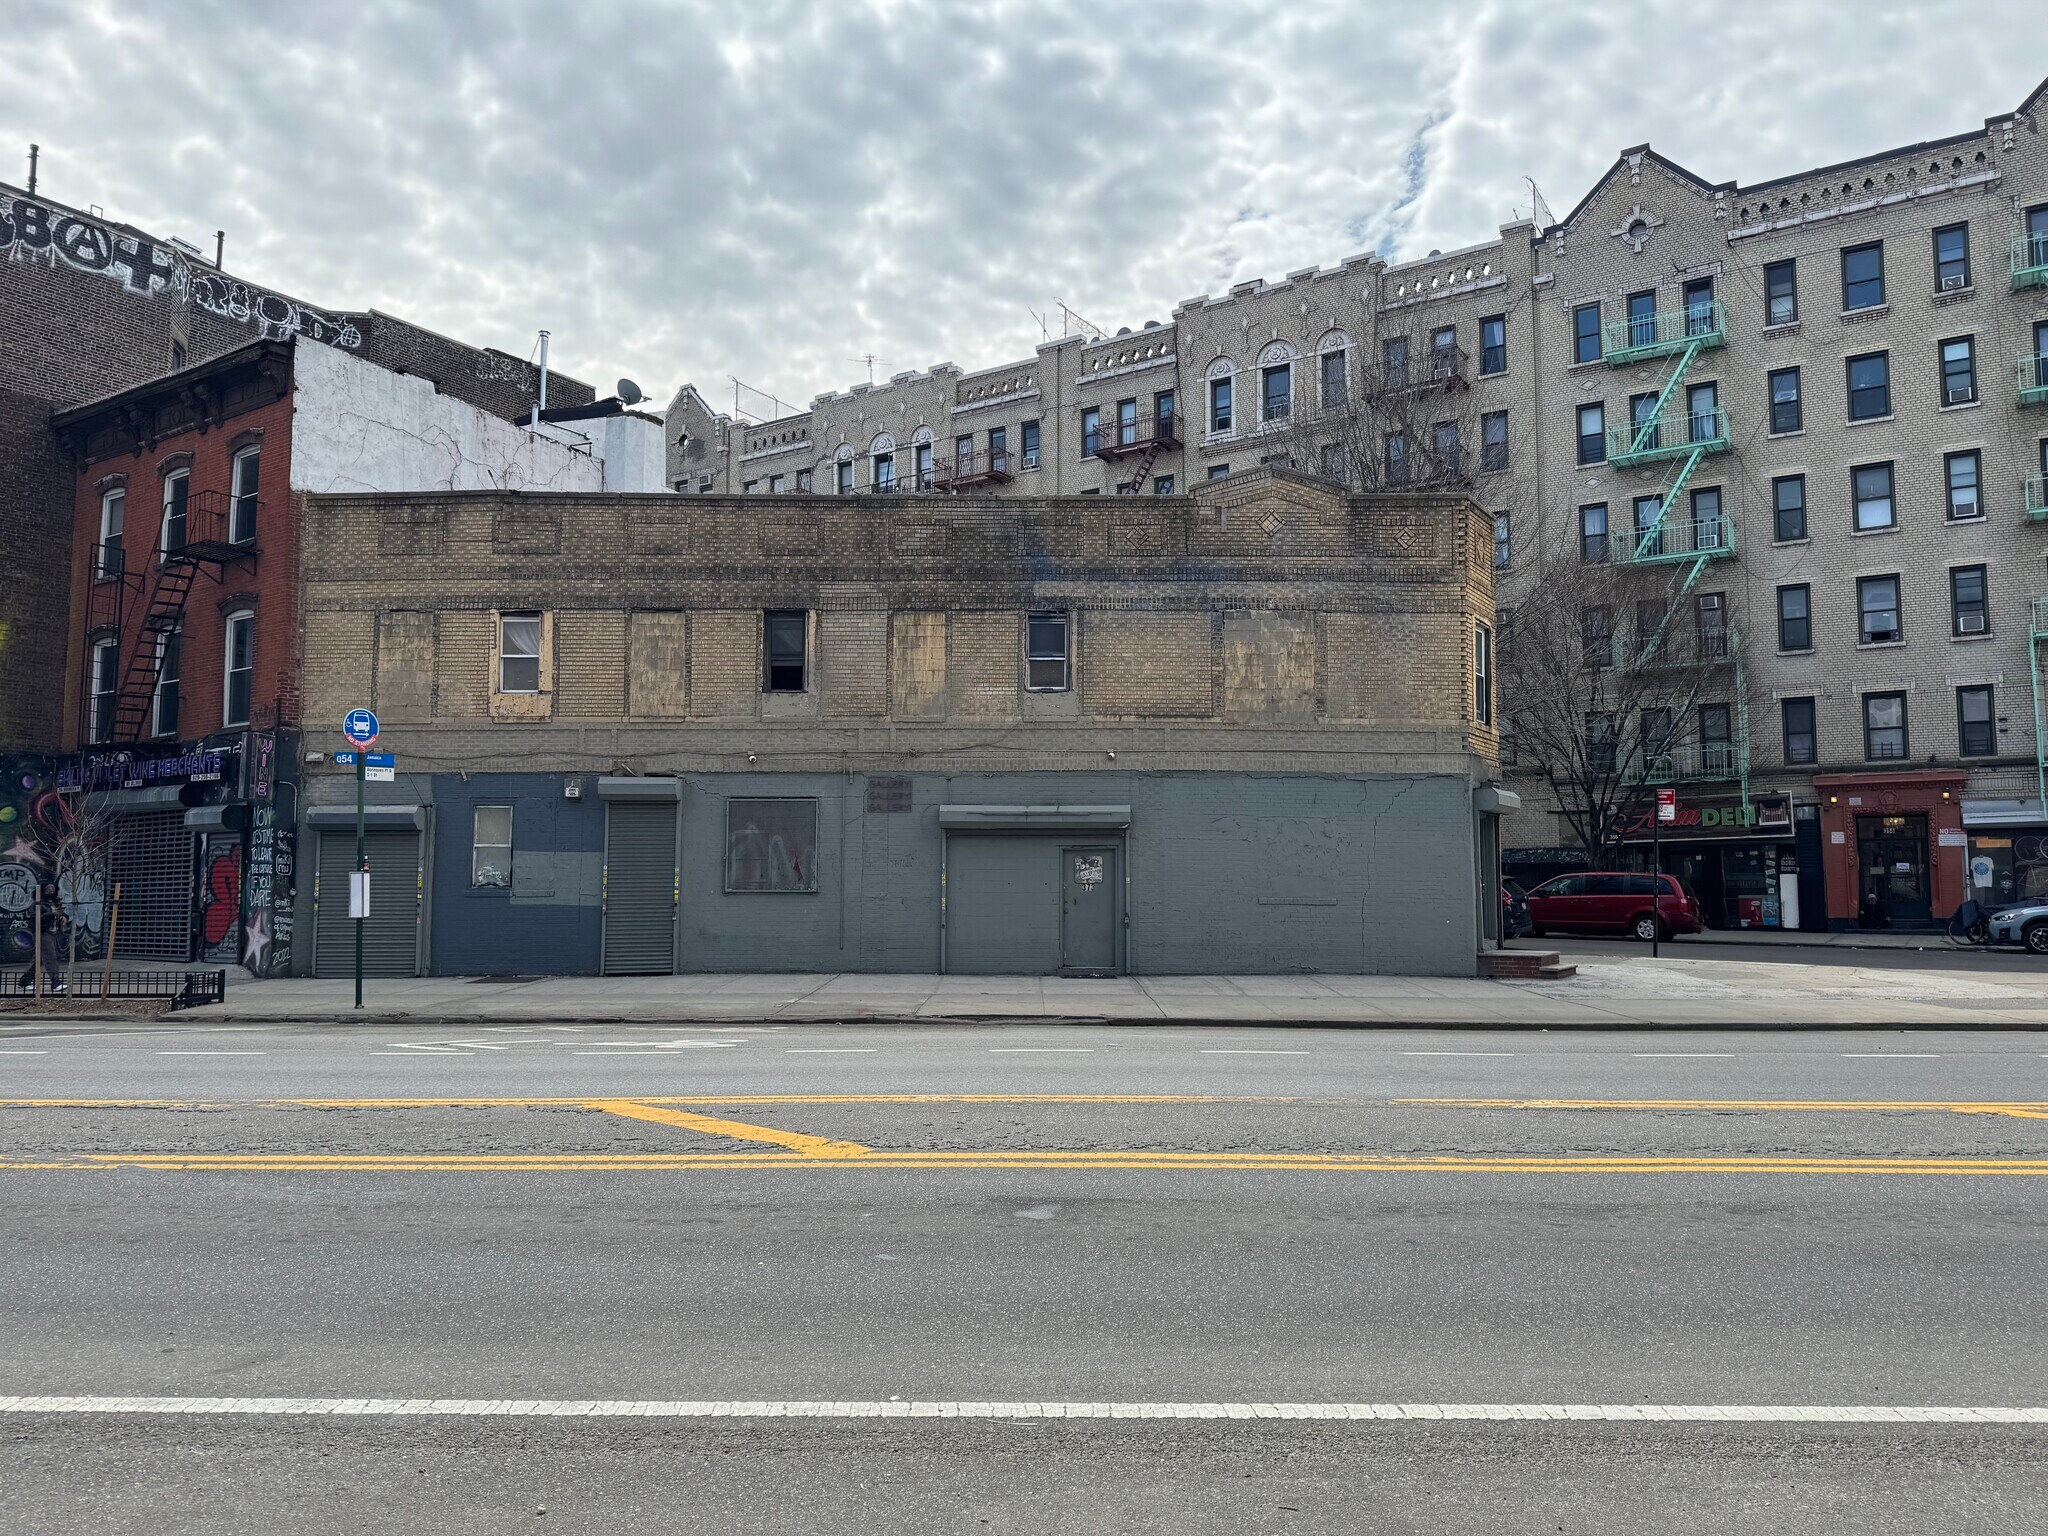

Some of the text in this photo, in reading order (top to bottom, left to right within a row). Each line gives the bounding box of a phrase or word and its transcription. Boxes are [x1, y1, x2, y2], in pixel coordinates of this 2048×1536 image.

[129, 760, 156, 779] WINE
[157, 753, 221, 778] MERCHANTS
[257, 738, 273, 796] WINE
[336, 754, 352, 764] Q54
[252, 806, 273, 827] NOW
[258, 875, 271, 889] YOU
[250, 889, 271, 907] DARE
